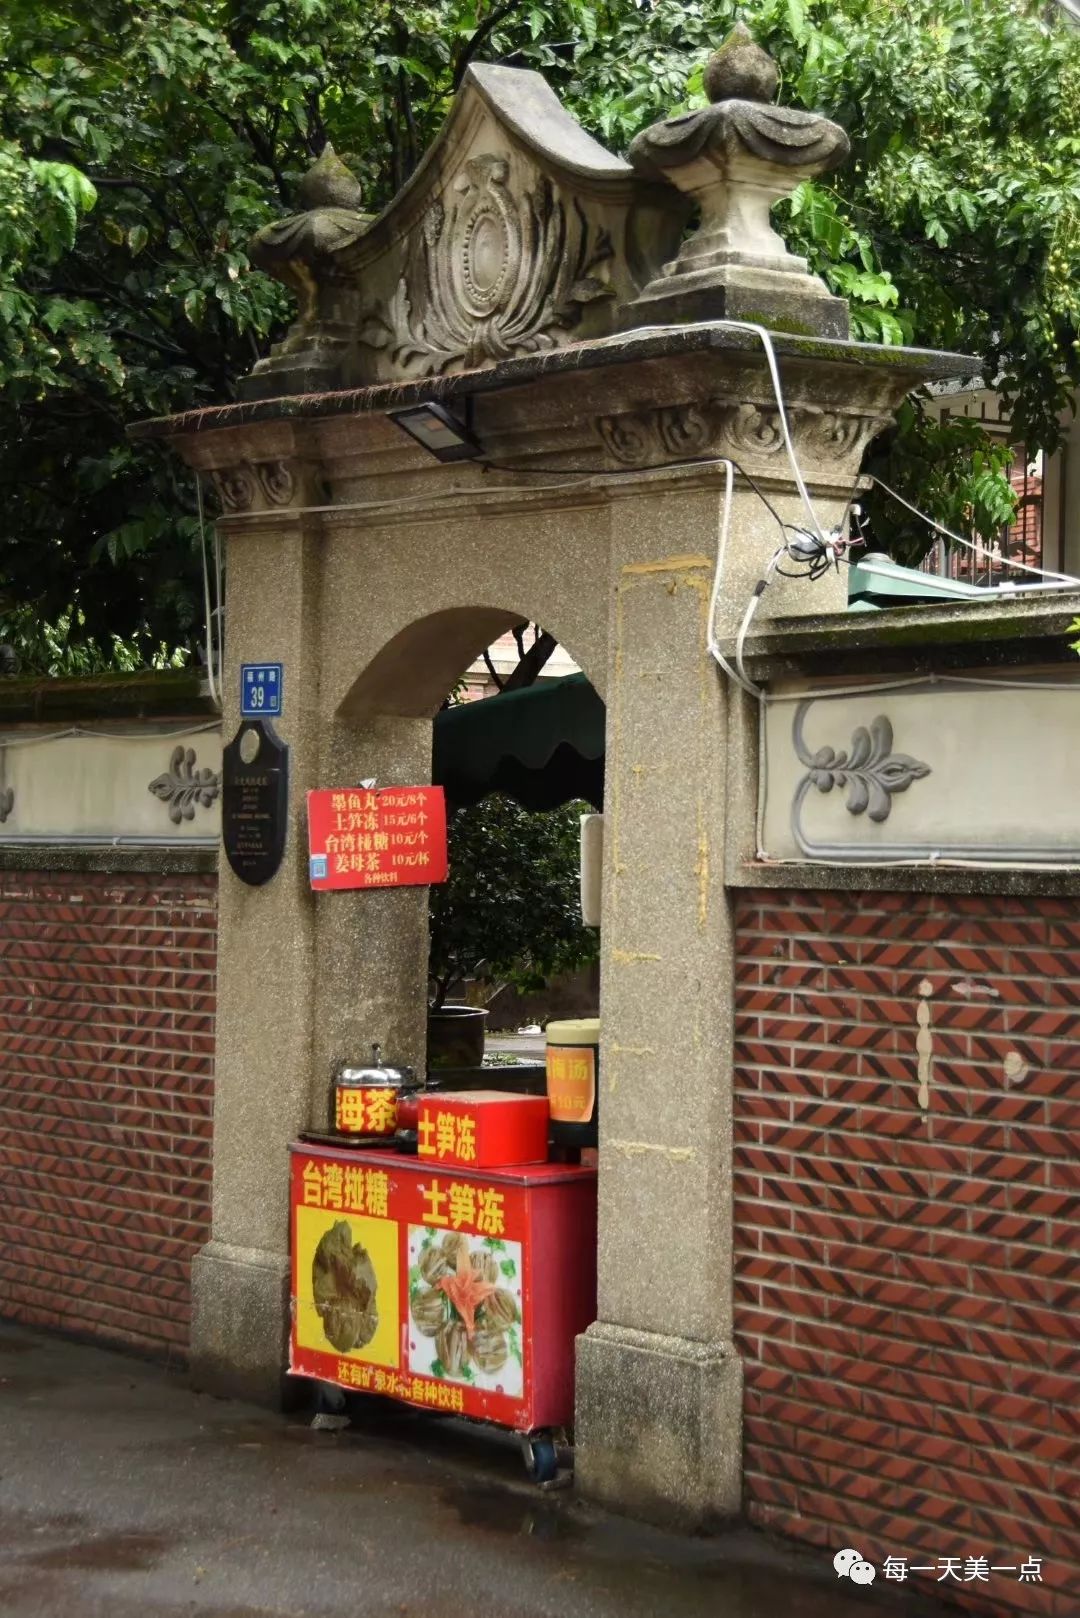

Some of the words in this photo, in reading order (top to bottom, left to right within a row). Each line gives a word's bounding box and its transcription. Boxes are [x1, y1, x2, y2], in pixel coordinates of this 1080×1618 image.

[251, 686, 264, 708] 39
[332, 792, 378, 811] 墨鱼丸
[382, 792, 427, 807] 20元/8个
[391, 830, 428, 845] 10元/个
[392, 851, 430, 866] 10元/杯
[336, 1087, 397, 1132] 母茶
[417, 1109, 476, 1161] 土笋冻
[422, 1179, 505, 1234] 土笋冻
